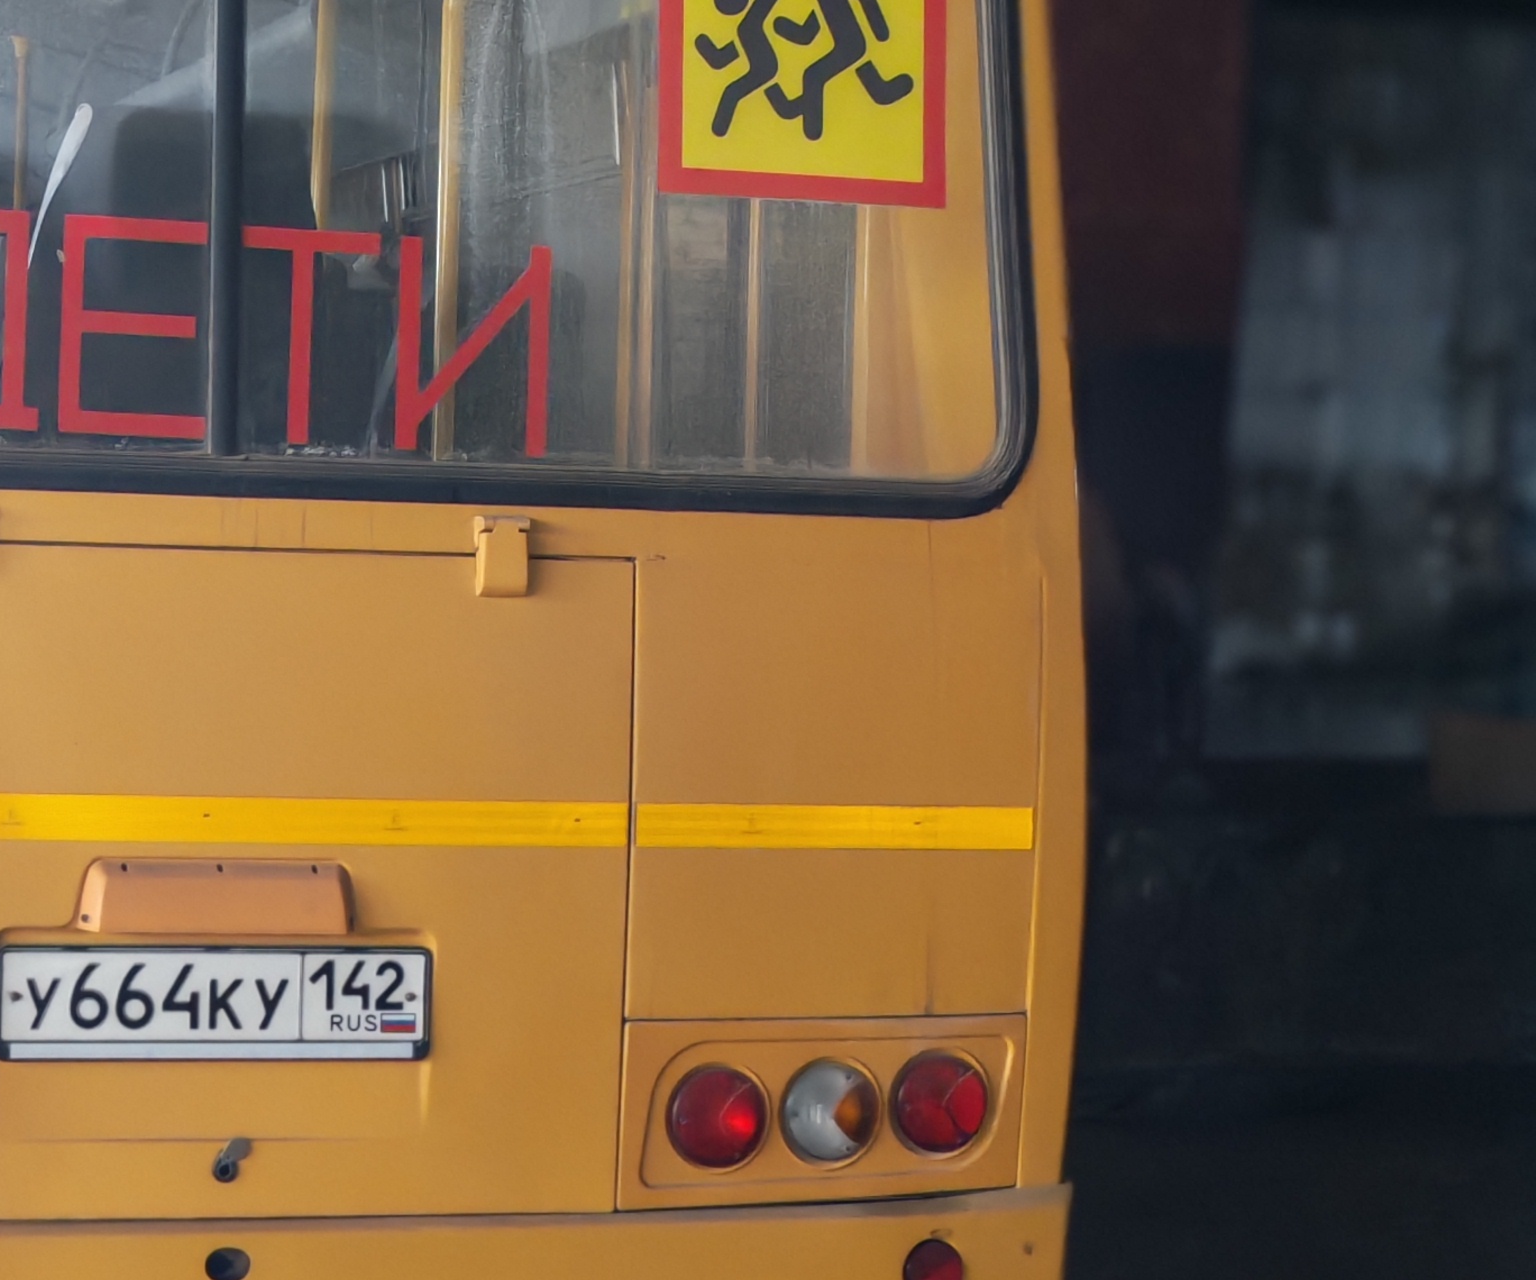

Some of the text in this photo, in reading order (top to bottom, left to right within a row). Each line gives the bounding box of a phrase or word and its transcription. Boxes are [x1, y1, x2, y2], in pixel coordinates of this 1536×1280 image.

[26, 960, 404, 1030] У664КУ 142
[330, 1014, 378, 1032] RUS
